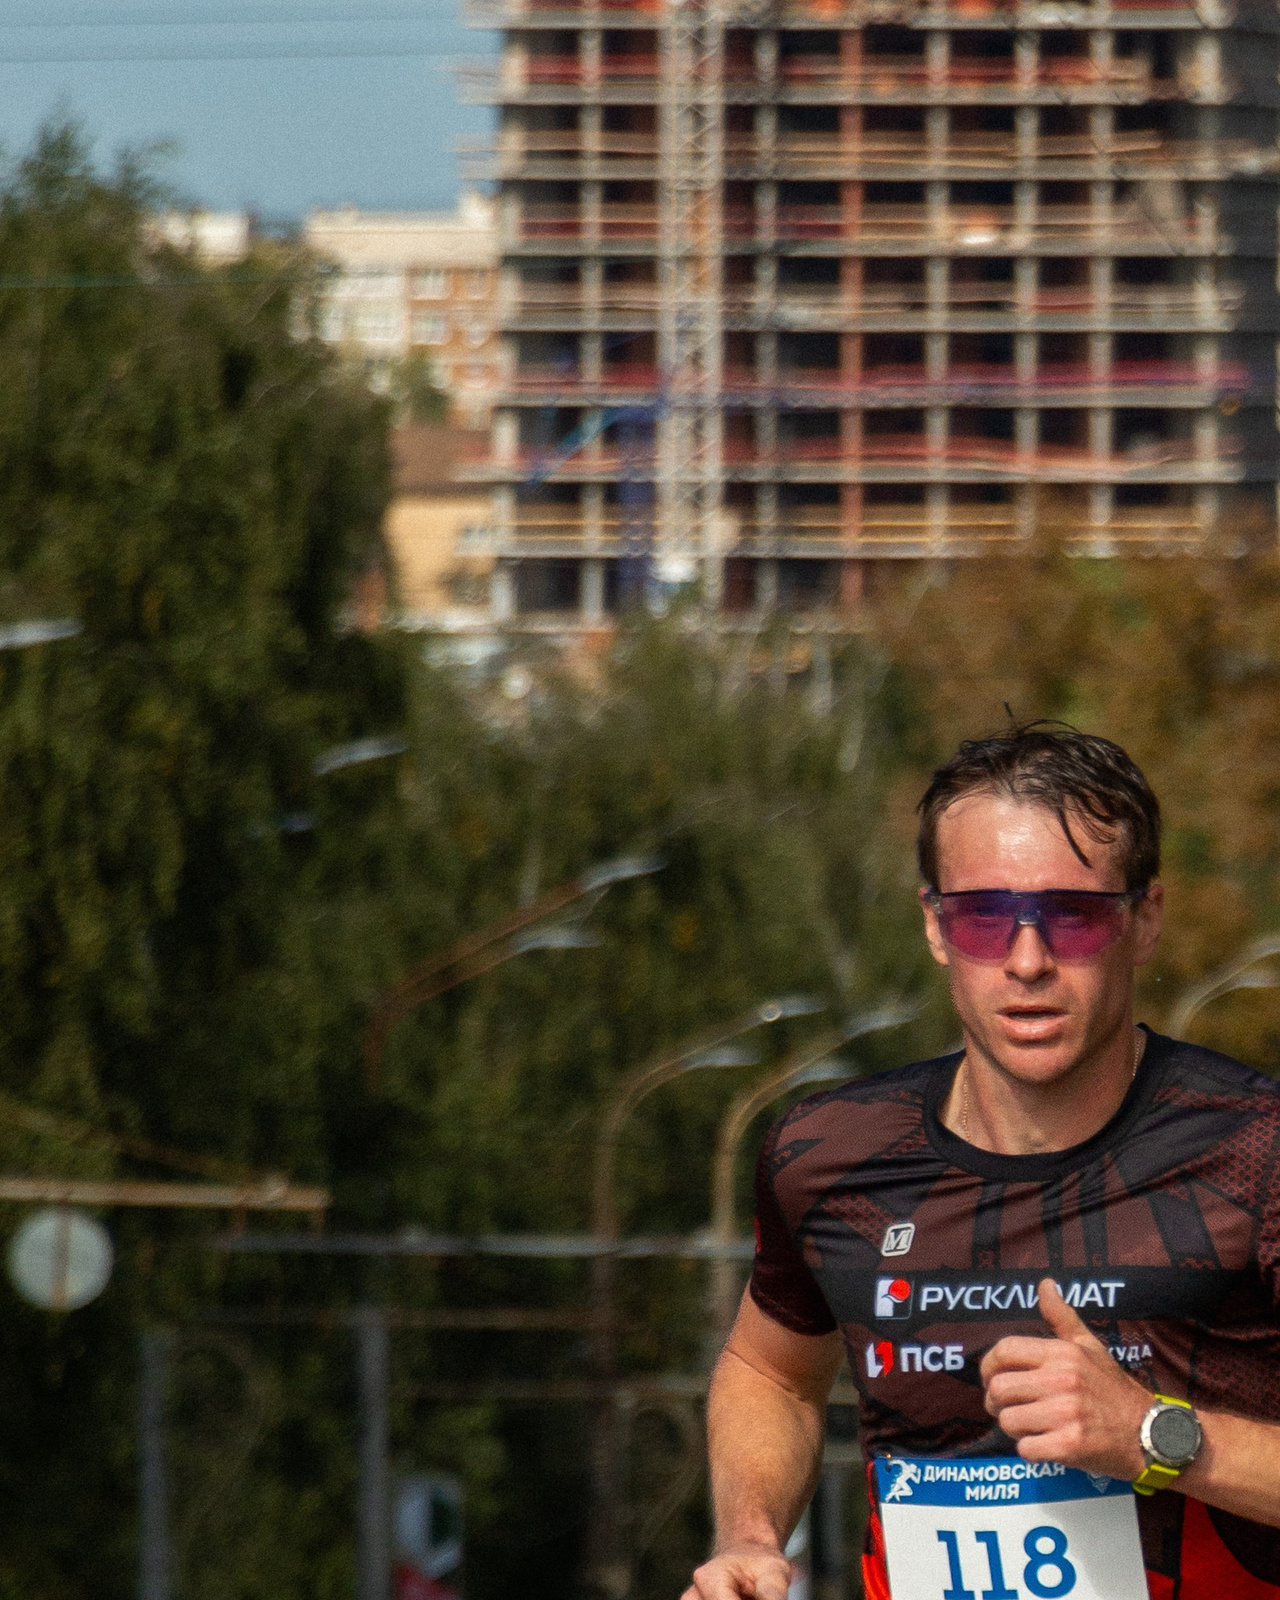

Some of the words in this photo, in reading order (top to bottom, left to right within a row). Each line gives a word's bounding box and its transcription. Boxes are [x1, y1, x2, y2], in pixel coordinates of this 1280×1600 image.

[901, 1345, 964, 1373] ПСБ
[923, 1461, 1066, 1483] ДИНАМОВСКАЯ
[965, 1483, 1020, 1501] МИЛЯ
